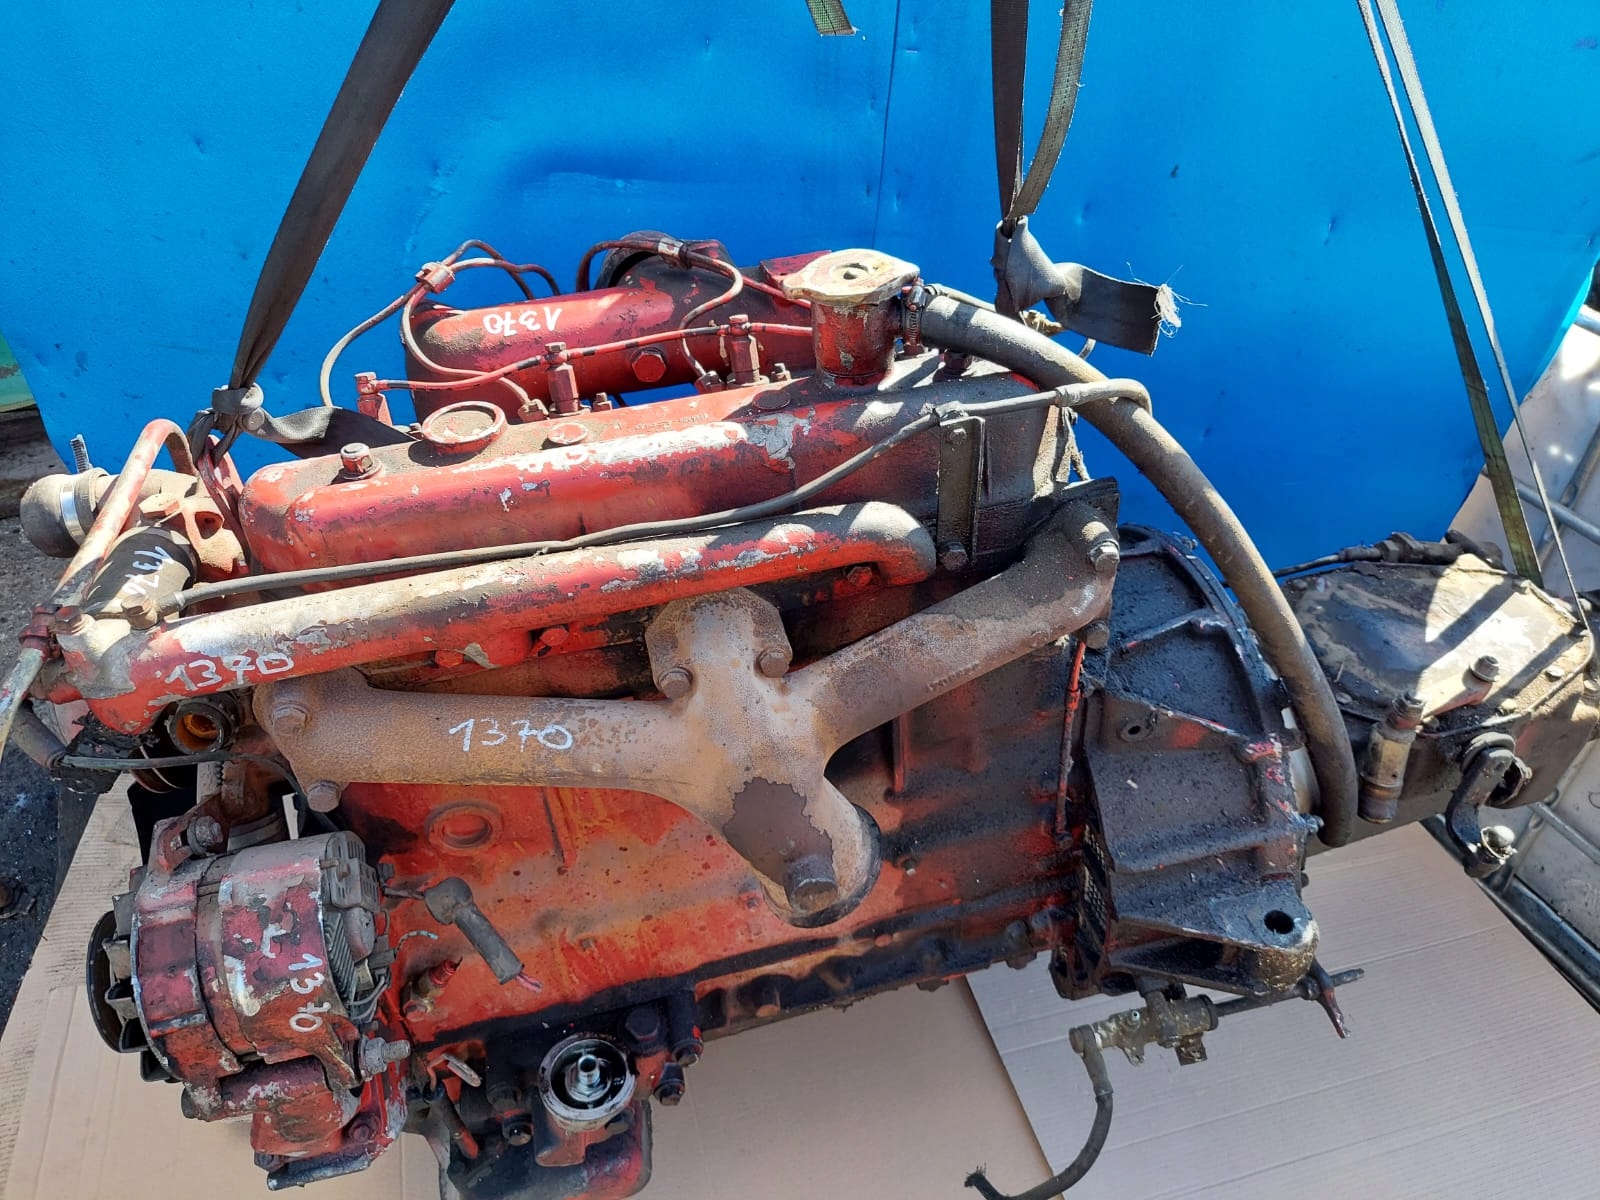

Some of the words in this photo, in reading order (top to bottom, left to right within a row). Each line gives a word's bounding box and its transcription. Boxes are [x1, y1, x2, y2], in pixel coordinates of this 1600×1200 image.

[483, 306, 562, 336] 1370
[164, 652, 294, 691] 1370
[448, 718, 573, 752] 1370
[288, 953, 331, 1033] 1370
